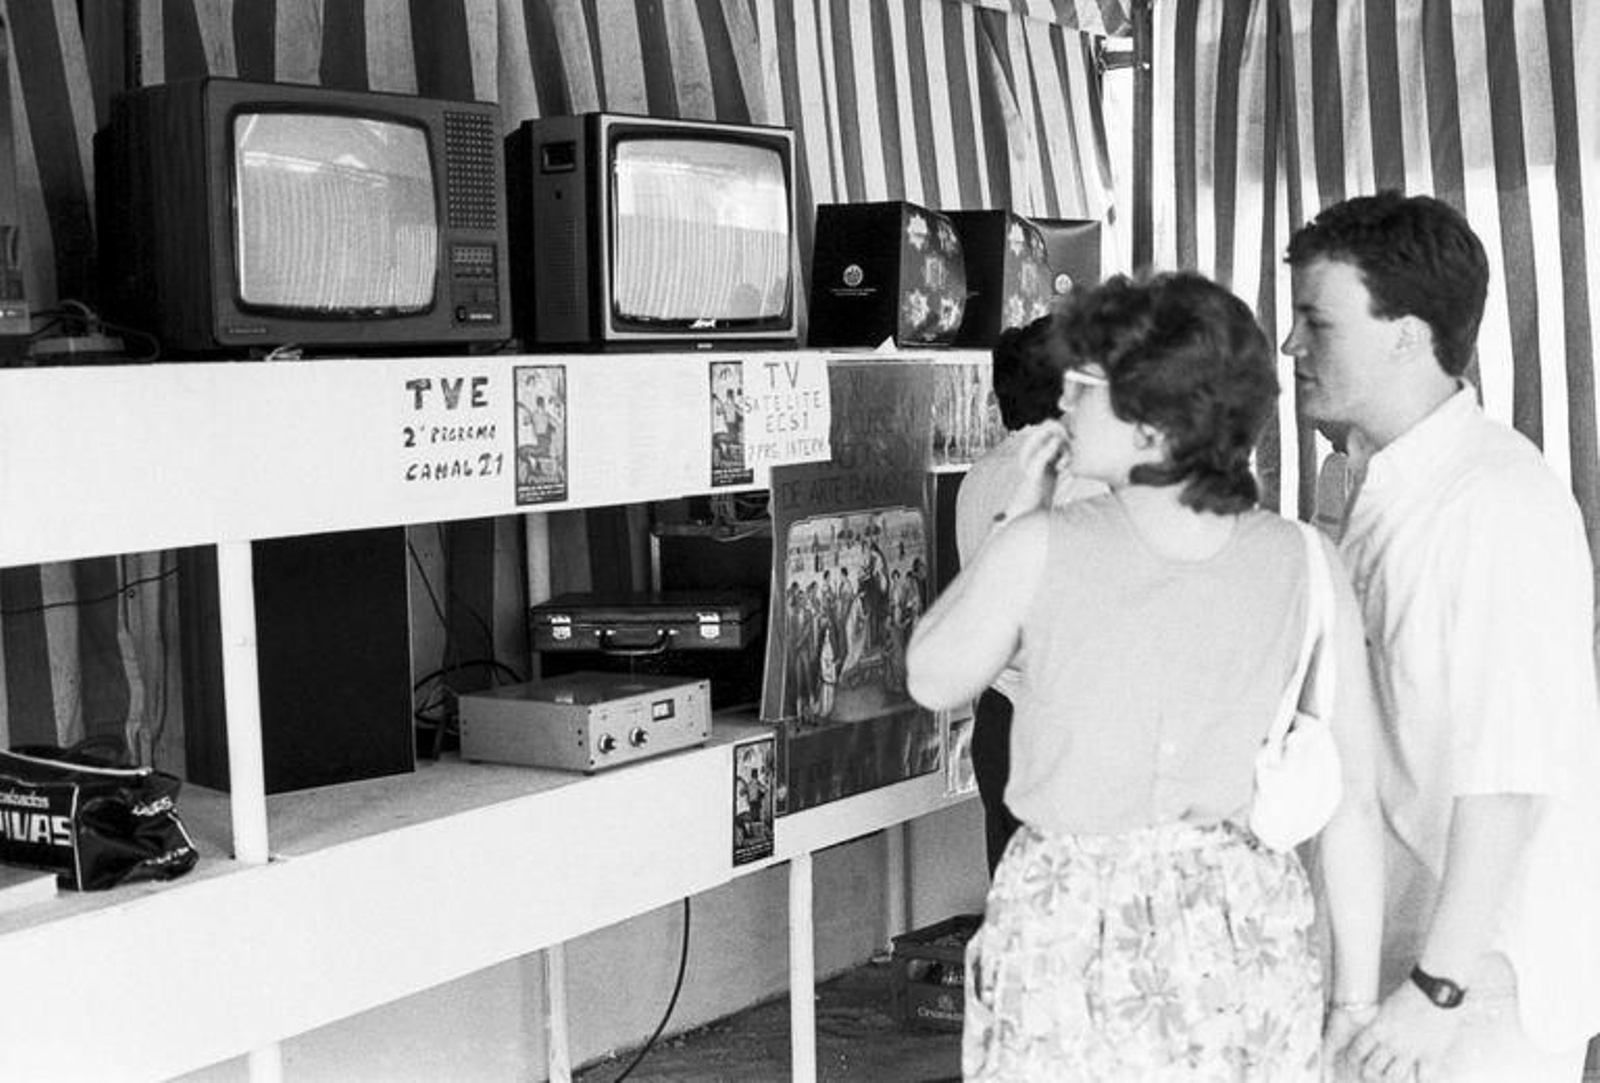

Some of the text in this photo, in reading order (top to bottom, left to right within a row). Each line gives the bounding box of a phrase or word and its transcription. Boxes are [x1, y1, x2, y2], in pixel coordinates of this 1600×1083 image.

[763, 361, 799, 388] TV
[405, 376, 489, 410] TVE
[405, 452, 503, 481] CANAL 21
